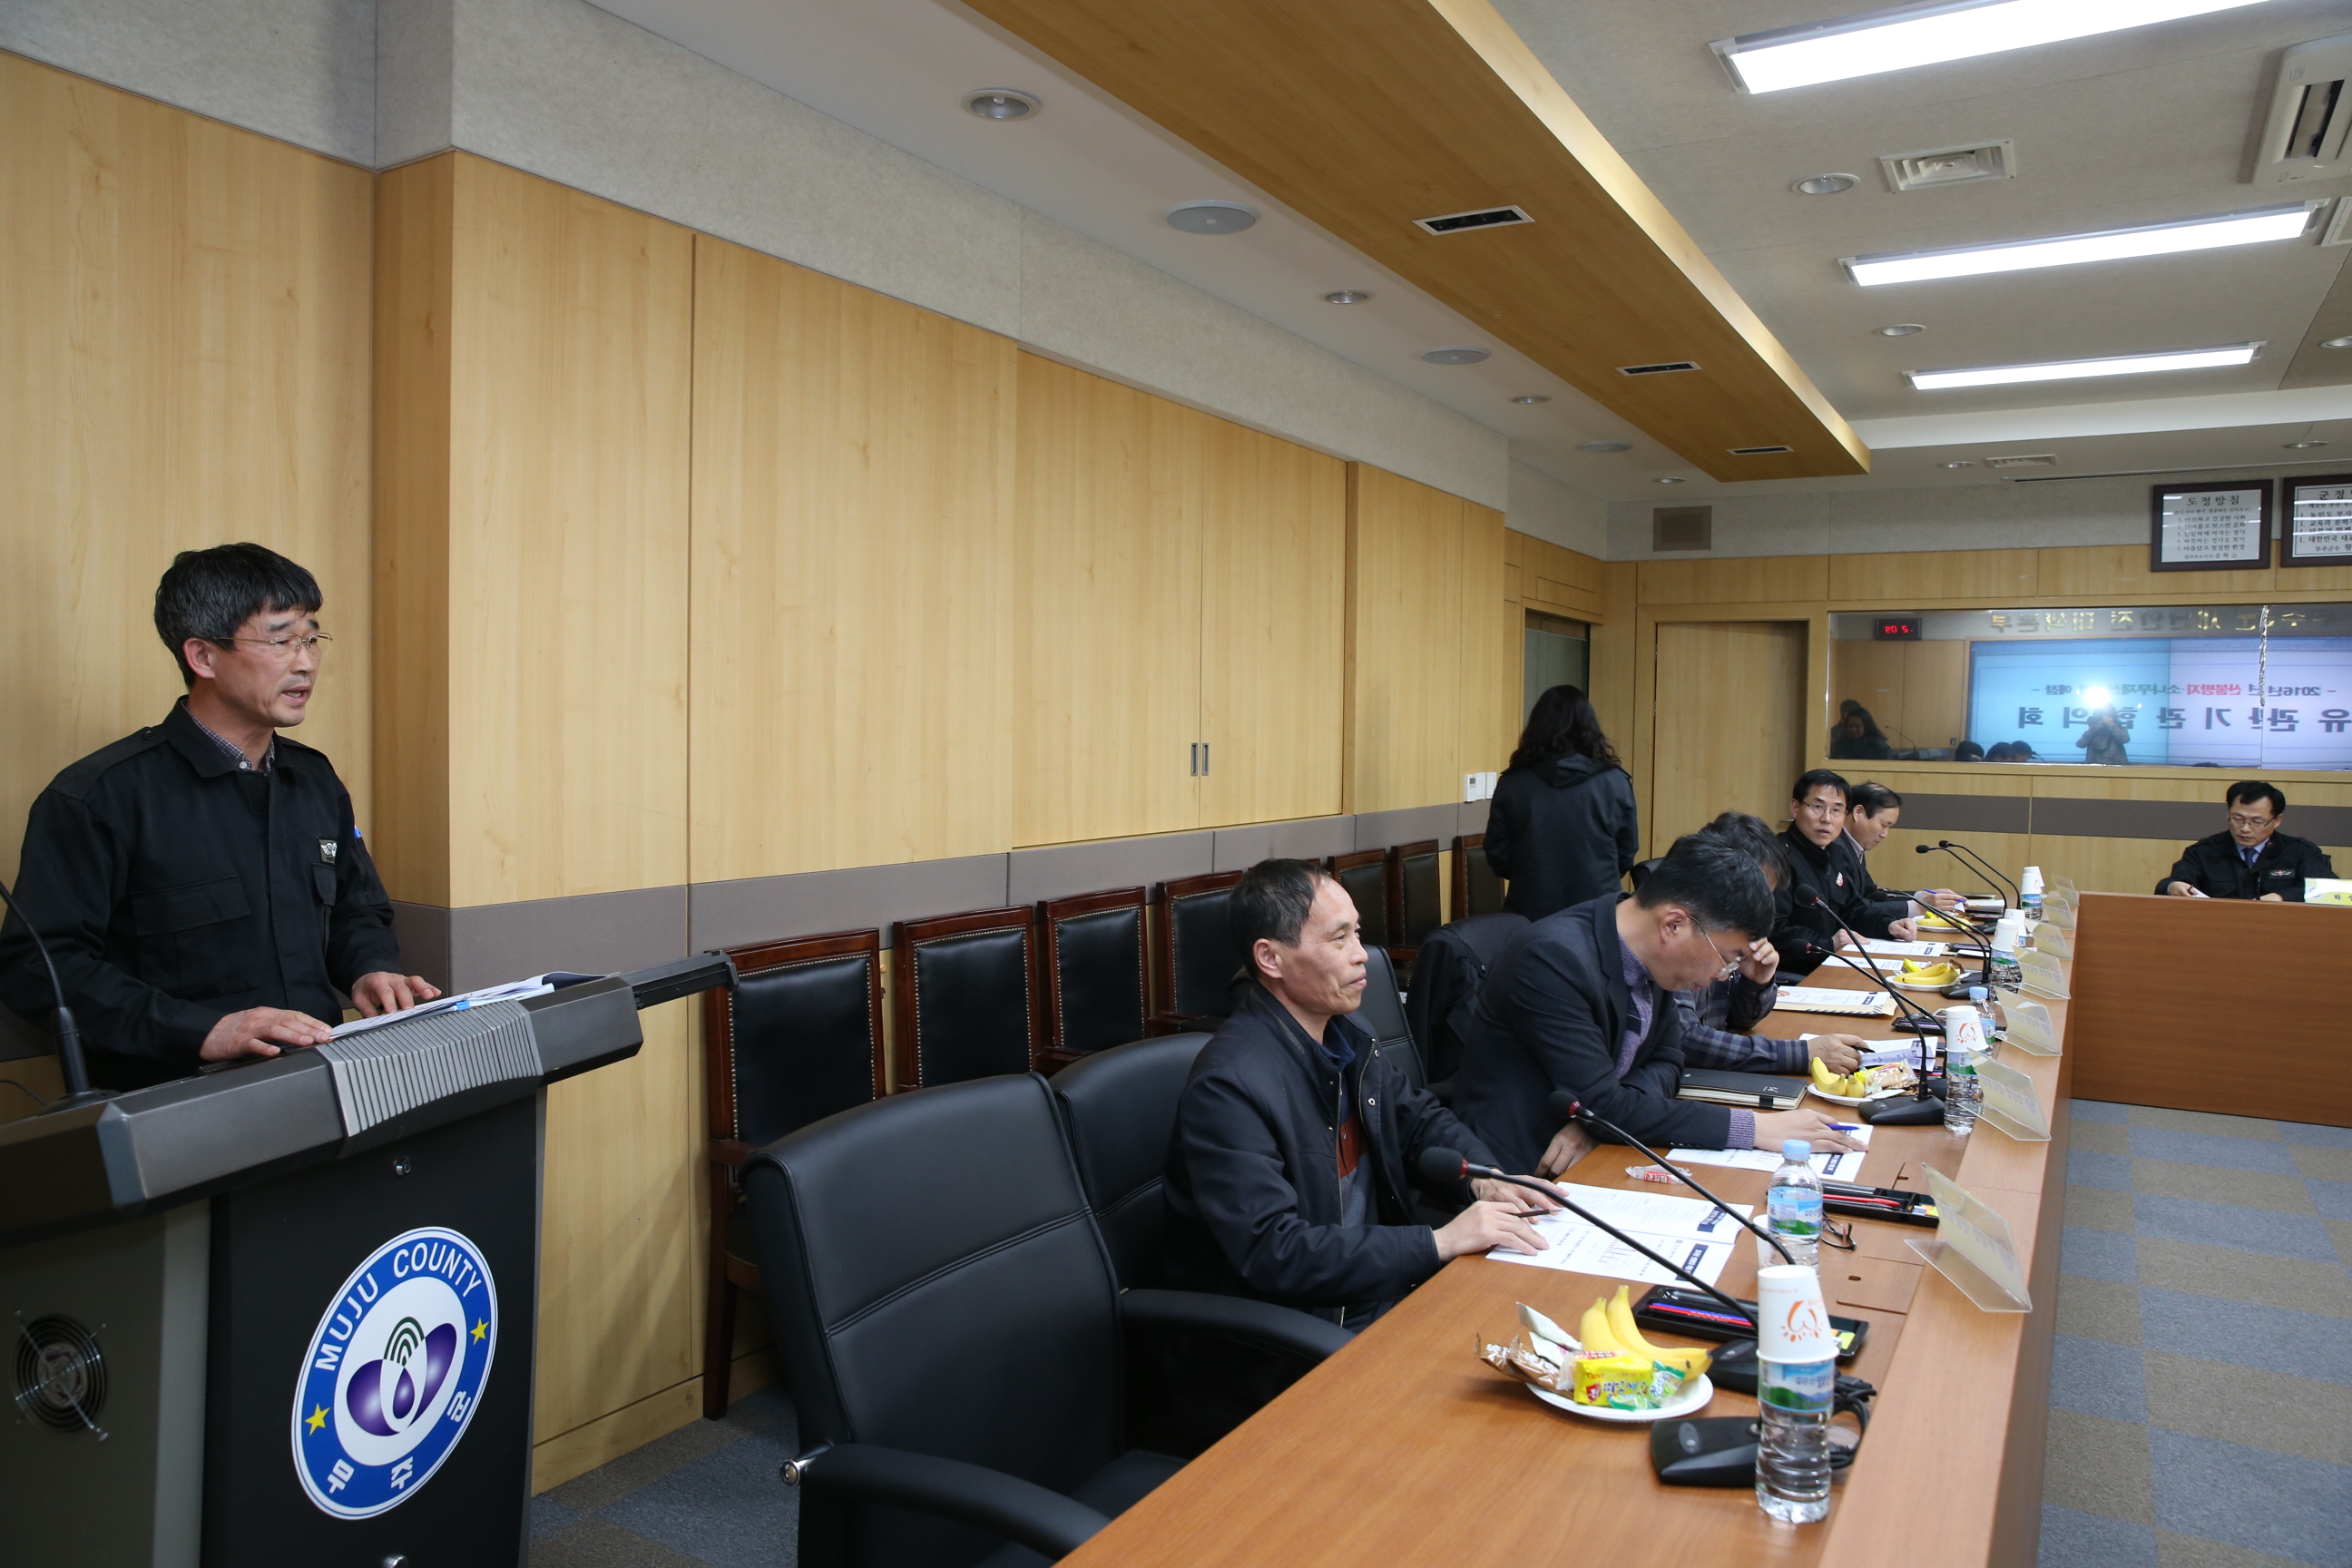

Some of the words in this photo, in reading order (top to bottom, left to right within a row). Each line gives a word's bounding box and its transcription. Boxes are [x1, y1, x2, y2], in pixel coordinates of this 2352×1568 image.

[2318, 489, 2352, 500] 군정
[2186, 495, 2239, 506] 도정방침
[314, 1272, 378, 1371] MUJU
[393, 1241, 482, 1298] COUNTY
